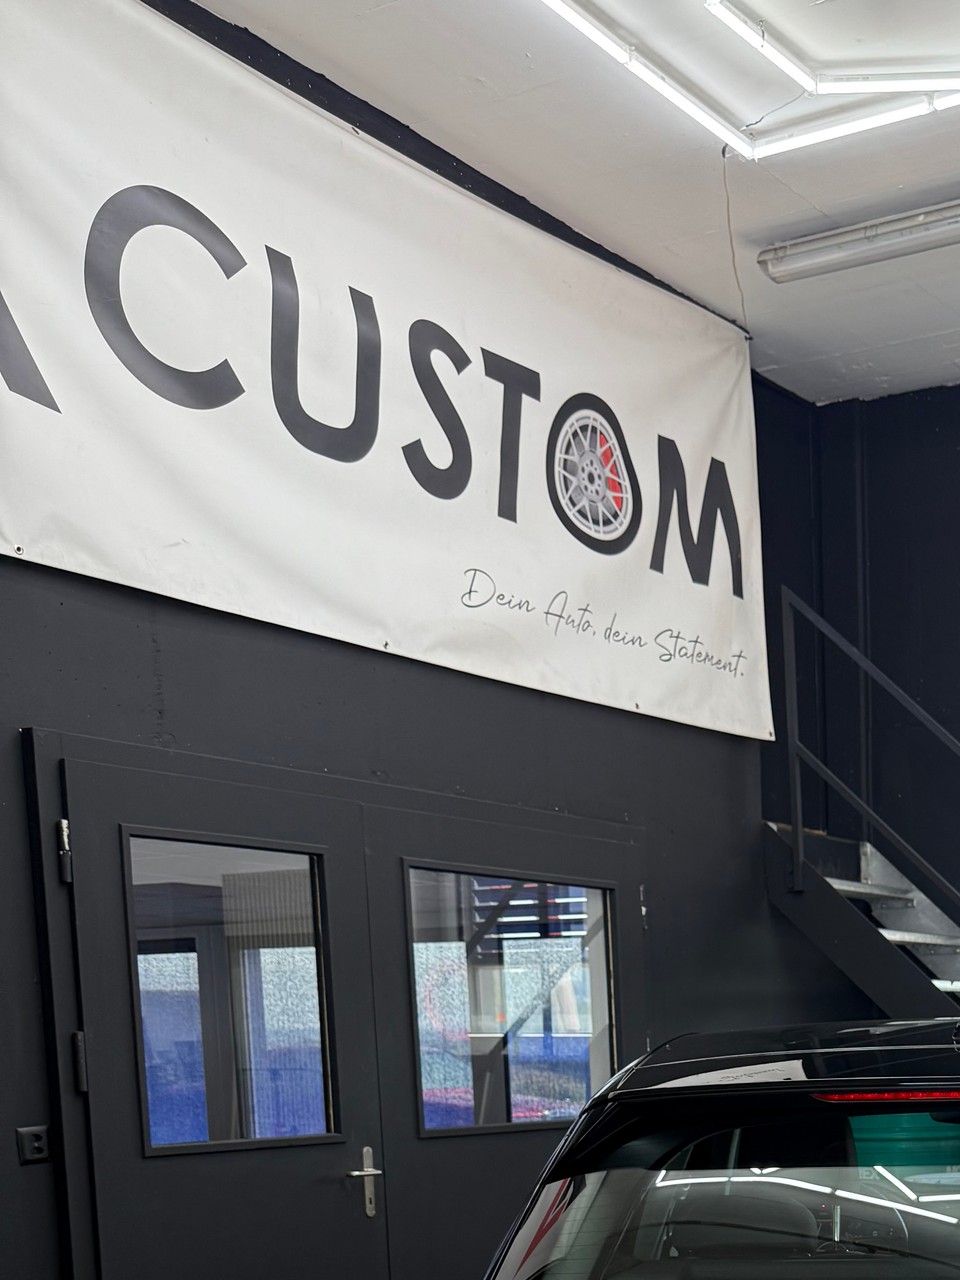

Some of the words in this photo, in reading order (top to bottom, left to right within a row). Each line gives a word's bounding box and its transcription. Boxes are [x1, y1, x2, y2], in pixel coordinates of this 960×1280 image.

[84, 184, 744, 600] CUSTOM
[461, 568, 536, 608] Dein
[543, 591, 600, 637] Auto,
[603, 613, 647, 648] dein
[654, 628, 748, 678] Statement.
